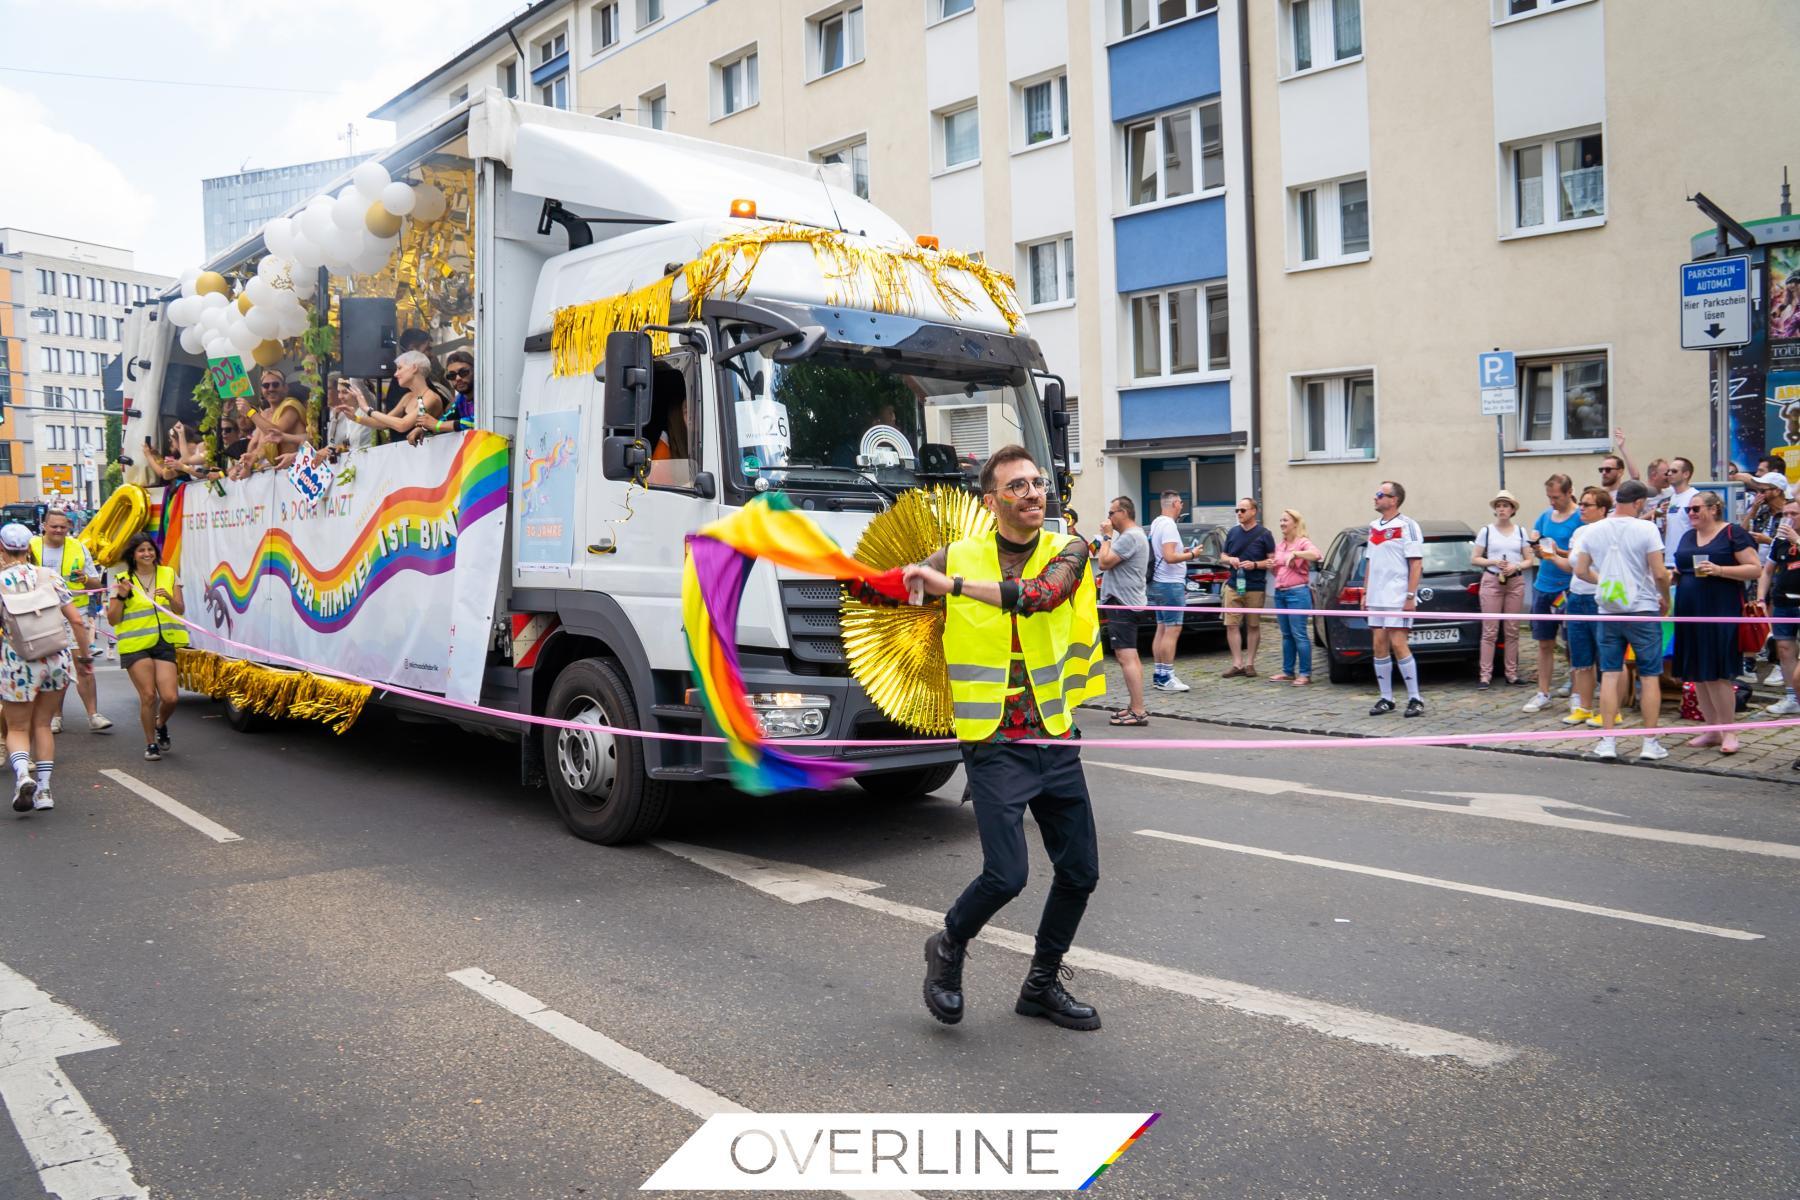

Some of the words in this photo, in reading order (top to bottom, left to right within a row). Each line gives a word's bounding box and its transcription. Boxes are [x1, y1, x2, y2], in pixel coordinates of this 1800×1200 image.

[1687, 265, 1741, 280] PARKSCHEIN-
[1696, 278, 1733, 291] AUTOMAT
[1684, 301, 1700, 310] Hier
[1703, 295, 1746, 308] Parkschein
[1704, 311, 1725, 320] lösen
[1484, 356, 1504, 384] P
[299, 470, 319, 495] HOMO
[280, 502, 288, 522] &
[322, 493, 354, 518] TANZT
[289, 558, 316, 612] DER
[319, 550, 371, 618] HIMMEL
[377, 517, 411, 558] IST
[419, 495, 461, 551] BUN
[1419, 630, 1433, 640] TO
[1433, 629, 1459, 640] 2874
